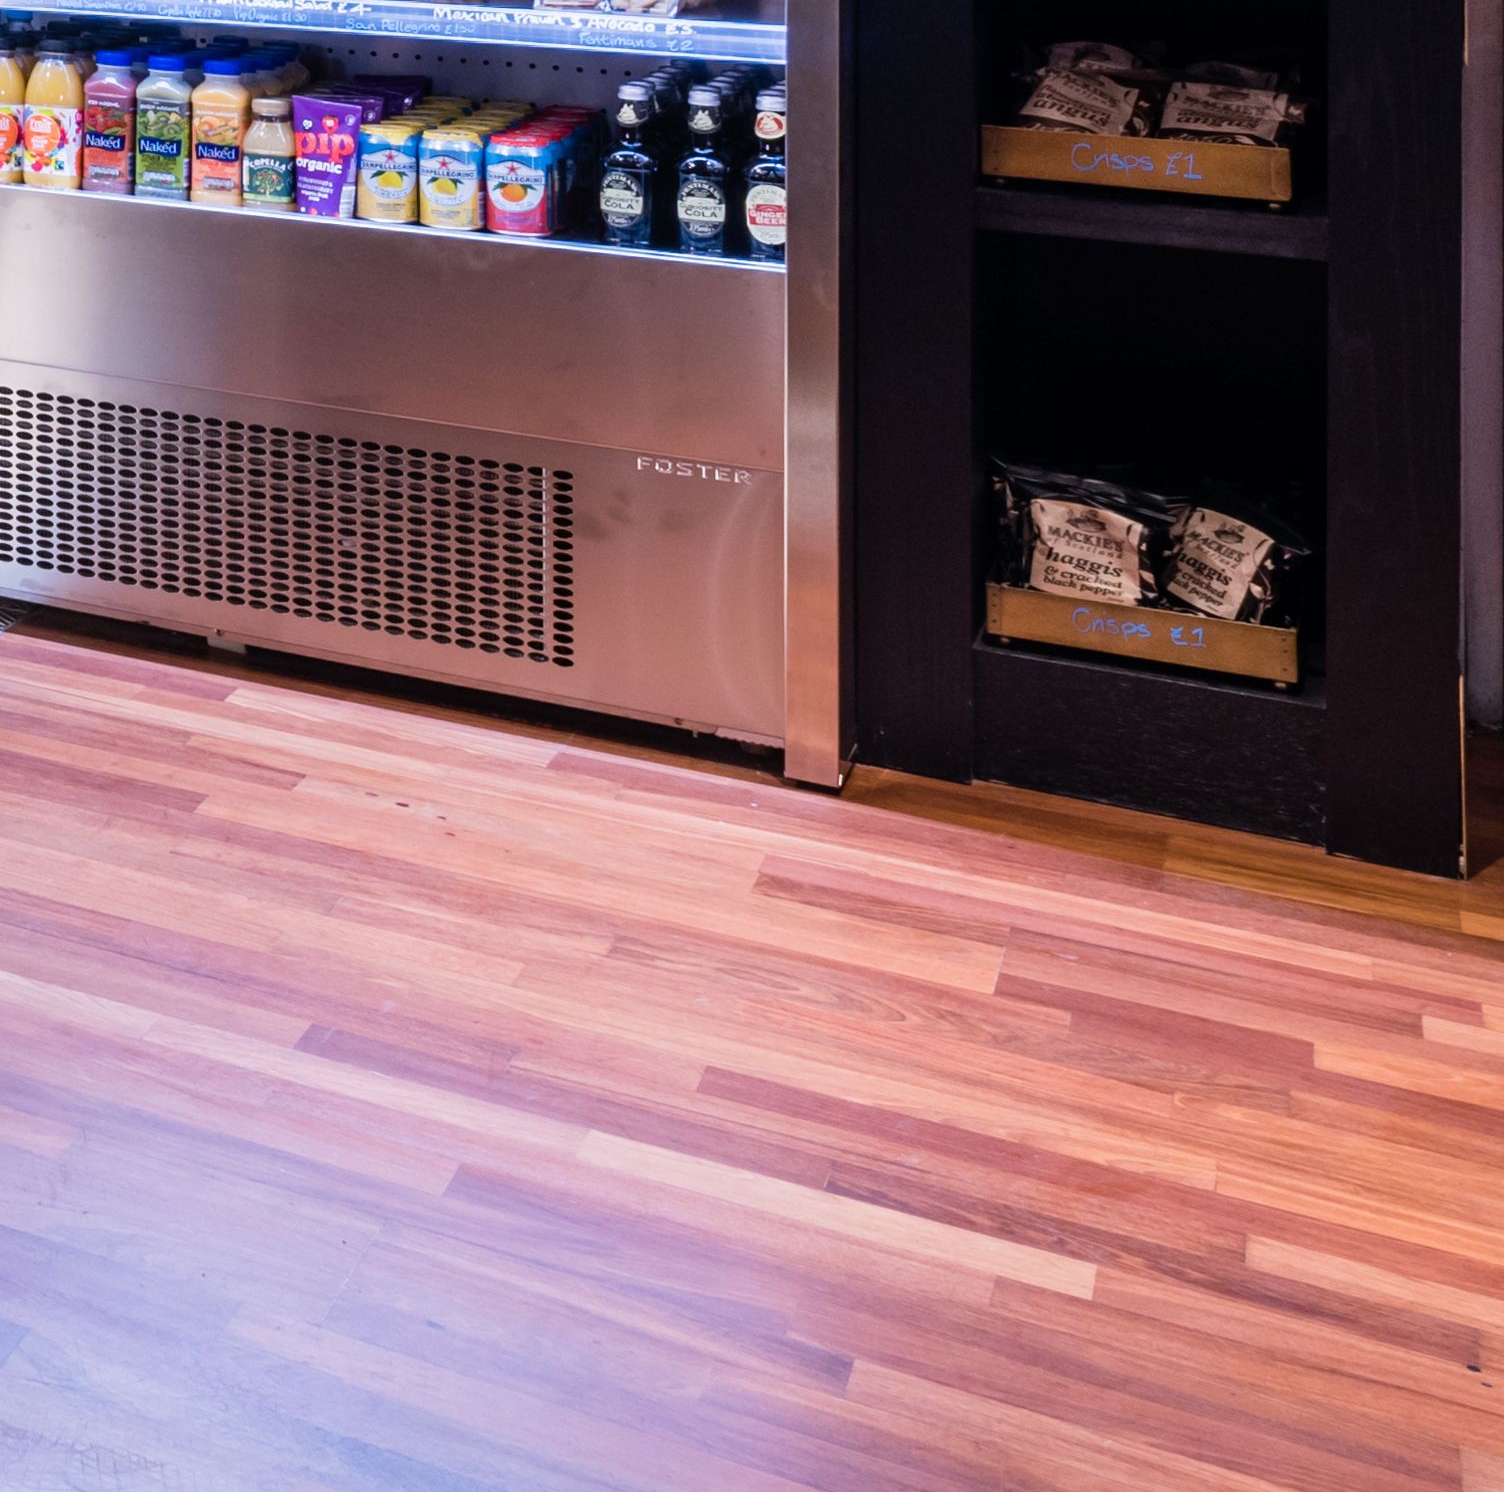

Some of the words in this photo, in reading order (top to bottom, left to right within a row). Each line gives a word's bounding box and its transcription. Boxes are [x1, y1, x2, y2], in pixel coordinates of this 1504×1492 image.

[346, 18, 376, 30] San
[381, 19, 440, 34] Pellegrino
[433, 8, 509, 22] Mexican
[514, 12, 564, 25] Prawn
[587, 17, 656, 32] Avocado
[580, 32, 657, 48] Fentimans
[1033, 96, 1110, 129] angus
[1176, 114, 1261, 130] angus
[86, 134, 121, 149] Naked
[140, 139, 177, 154] Naked
[198, 146, 236, 160] Naked
[295, 131, 355, 164] pip
[248, 158, 286, 170] COPELLA
[296, 157, 342, 174] organic
[1071, 142, 1154, 179] Crisps
[1166, 153, 1203, 180] £1
[604, 200, 634, 211] COLA
[685, 208, 718, 219] COLA
[637, 456, 752, 485] FOSTER
[1047, 526, 1124, 553] MACKIE'S
[1189, 530, 1250, 563] MACKIE'S
[1045, 547, 1123, 578] haggis
[1042, 576, 1077, 590] black
[1078, 580, 1125, 601] pepper
[1061, 568, 1122, 590] cracked
[1183, 570, 1230, 599] cracked
[1187, 584, 1224, 608] pepper
[1072, 607, 1153, 643] Crisps
